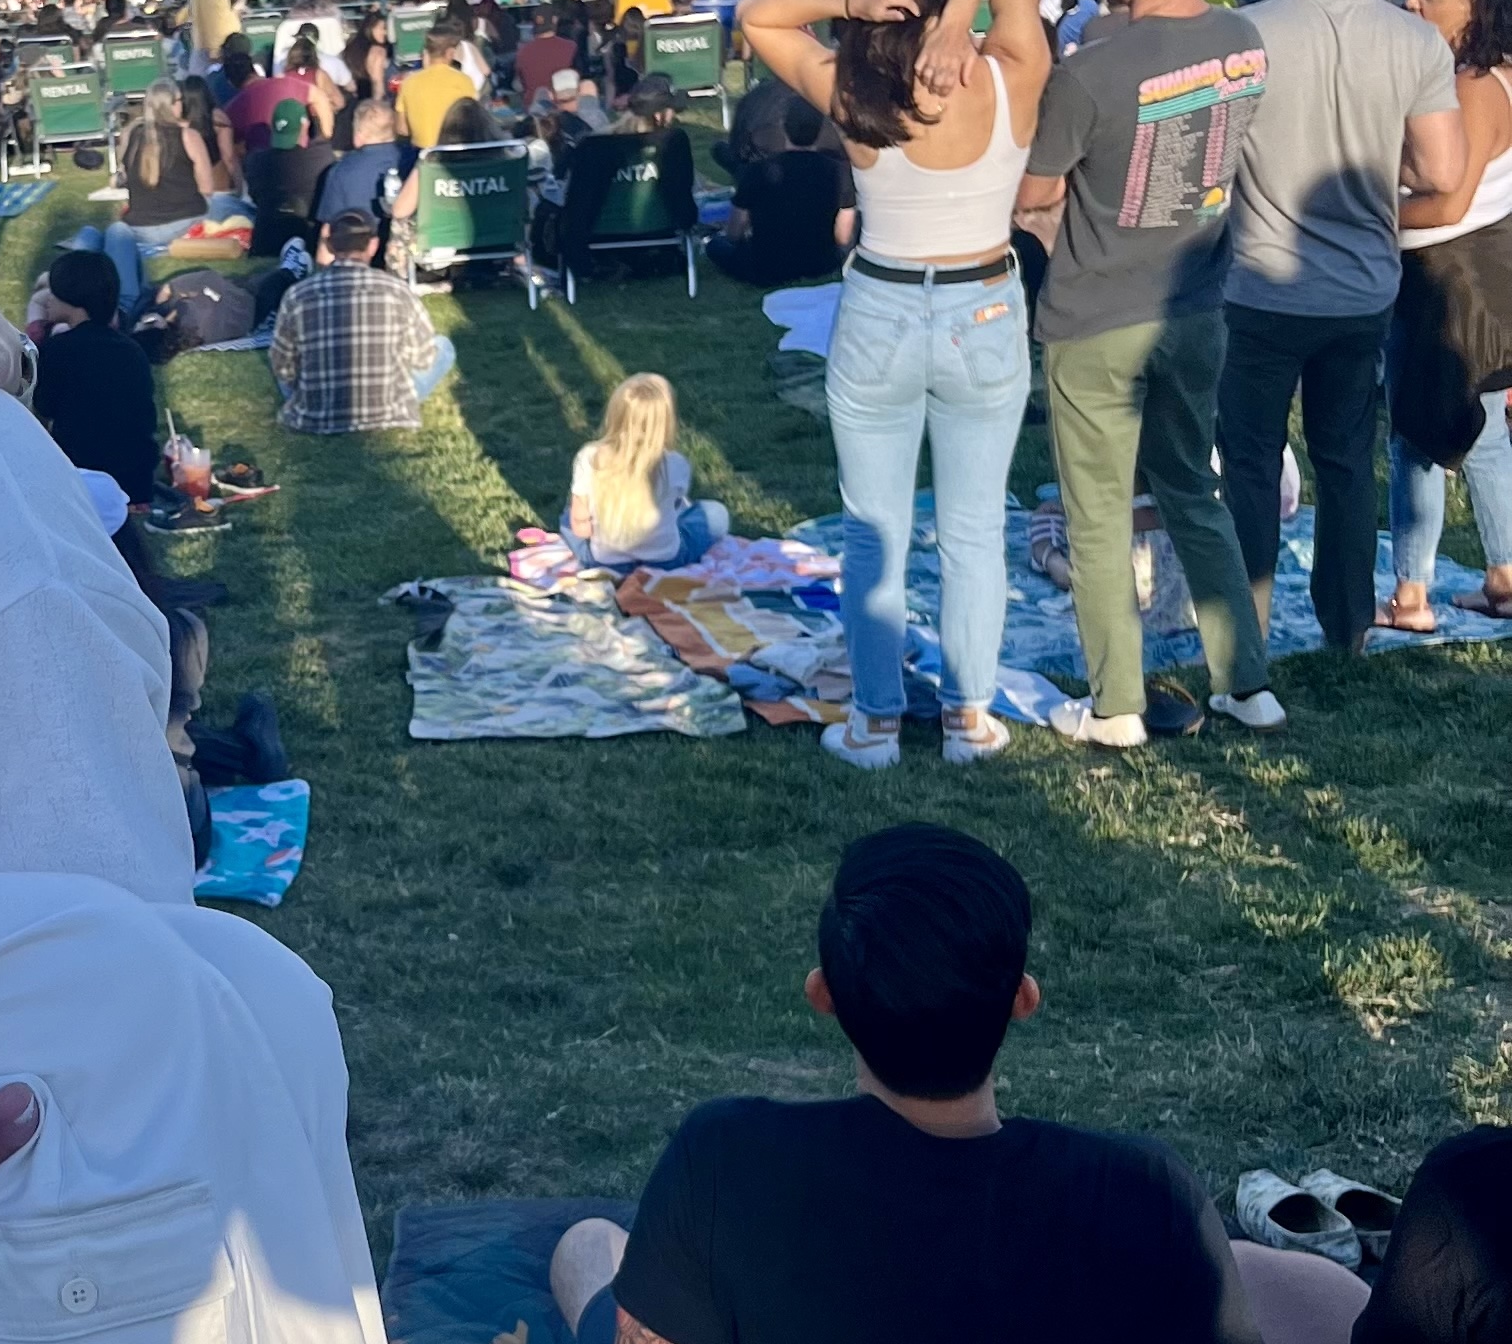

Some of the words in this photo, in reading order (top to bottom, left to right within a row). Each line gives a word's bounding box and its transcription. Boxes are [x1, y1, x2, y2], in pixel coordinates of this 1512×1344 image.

[656, 36, 710, 53] RENTAL
[113, 47, 155, 60] RENTAL
[40, 83, 91, 98] RENTAL
[434, 176, 509, 198] RENTAL
